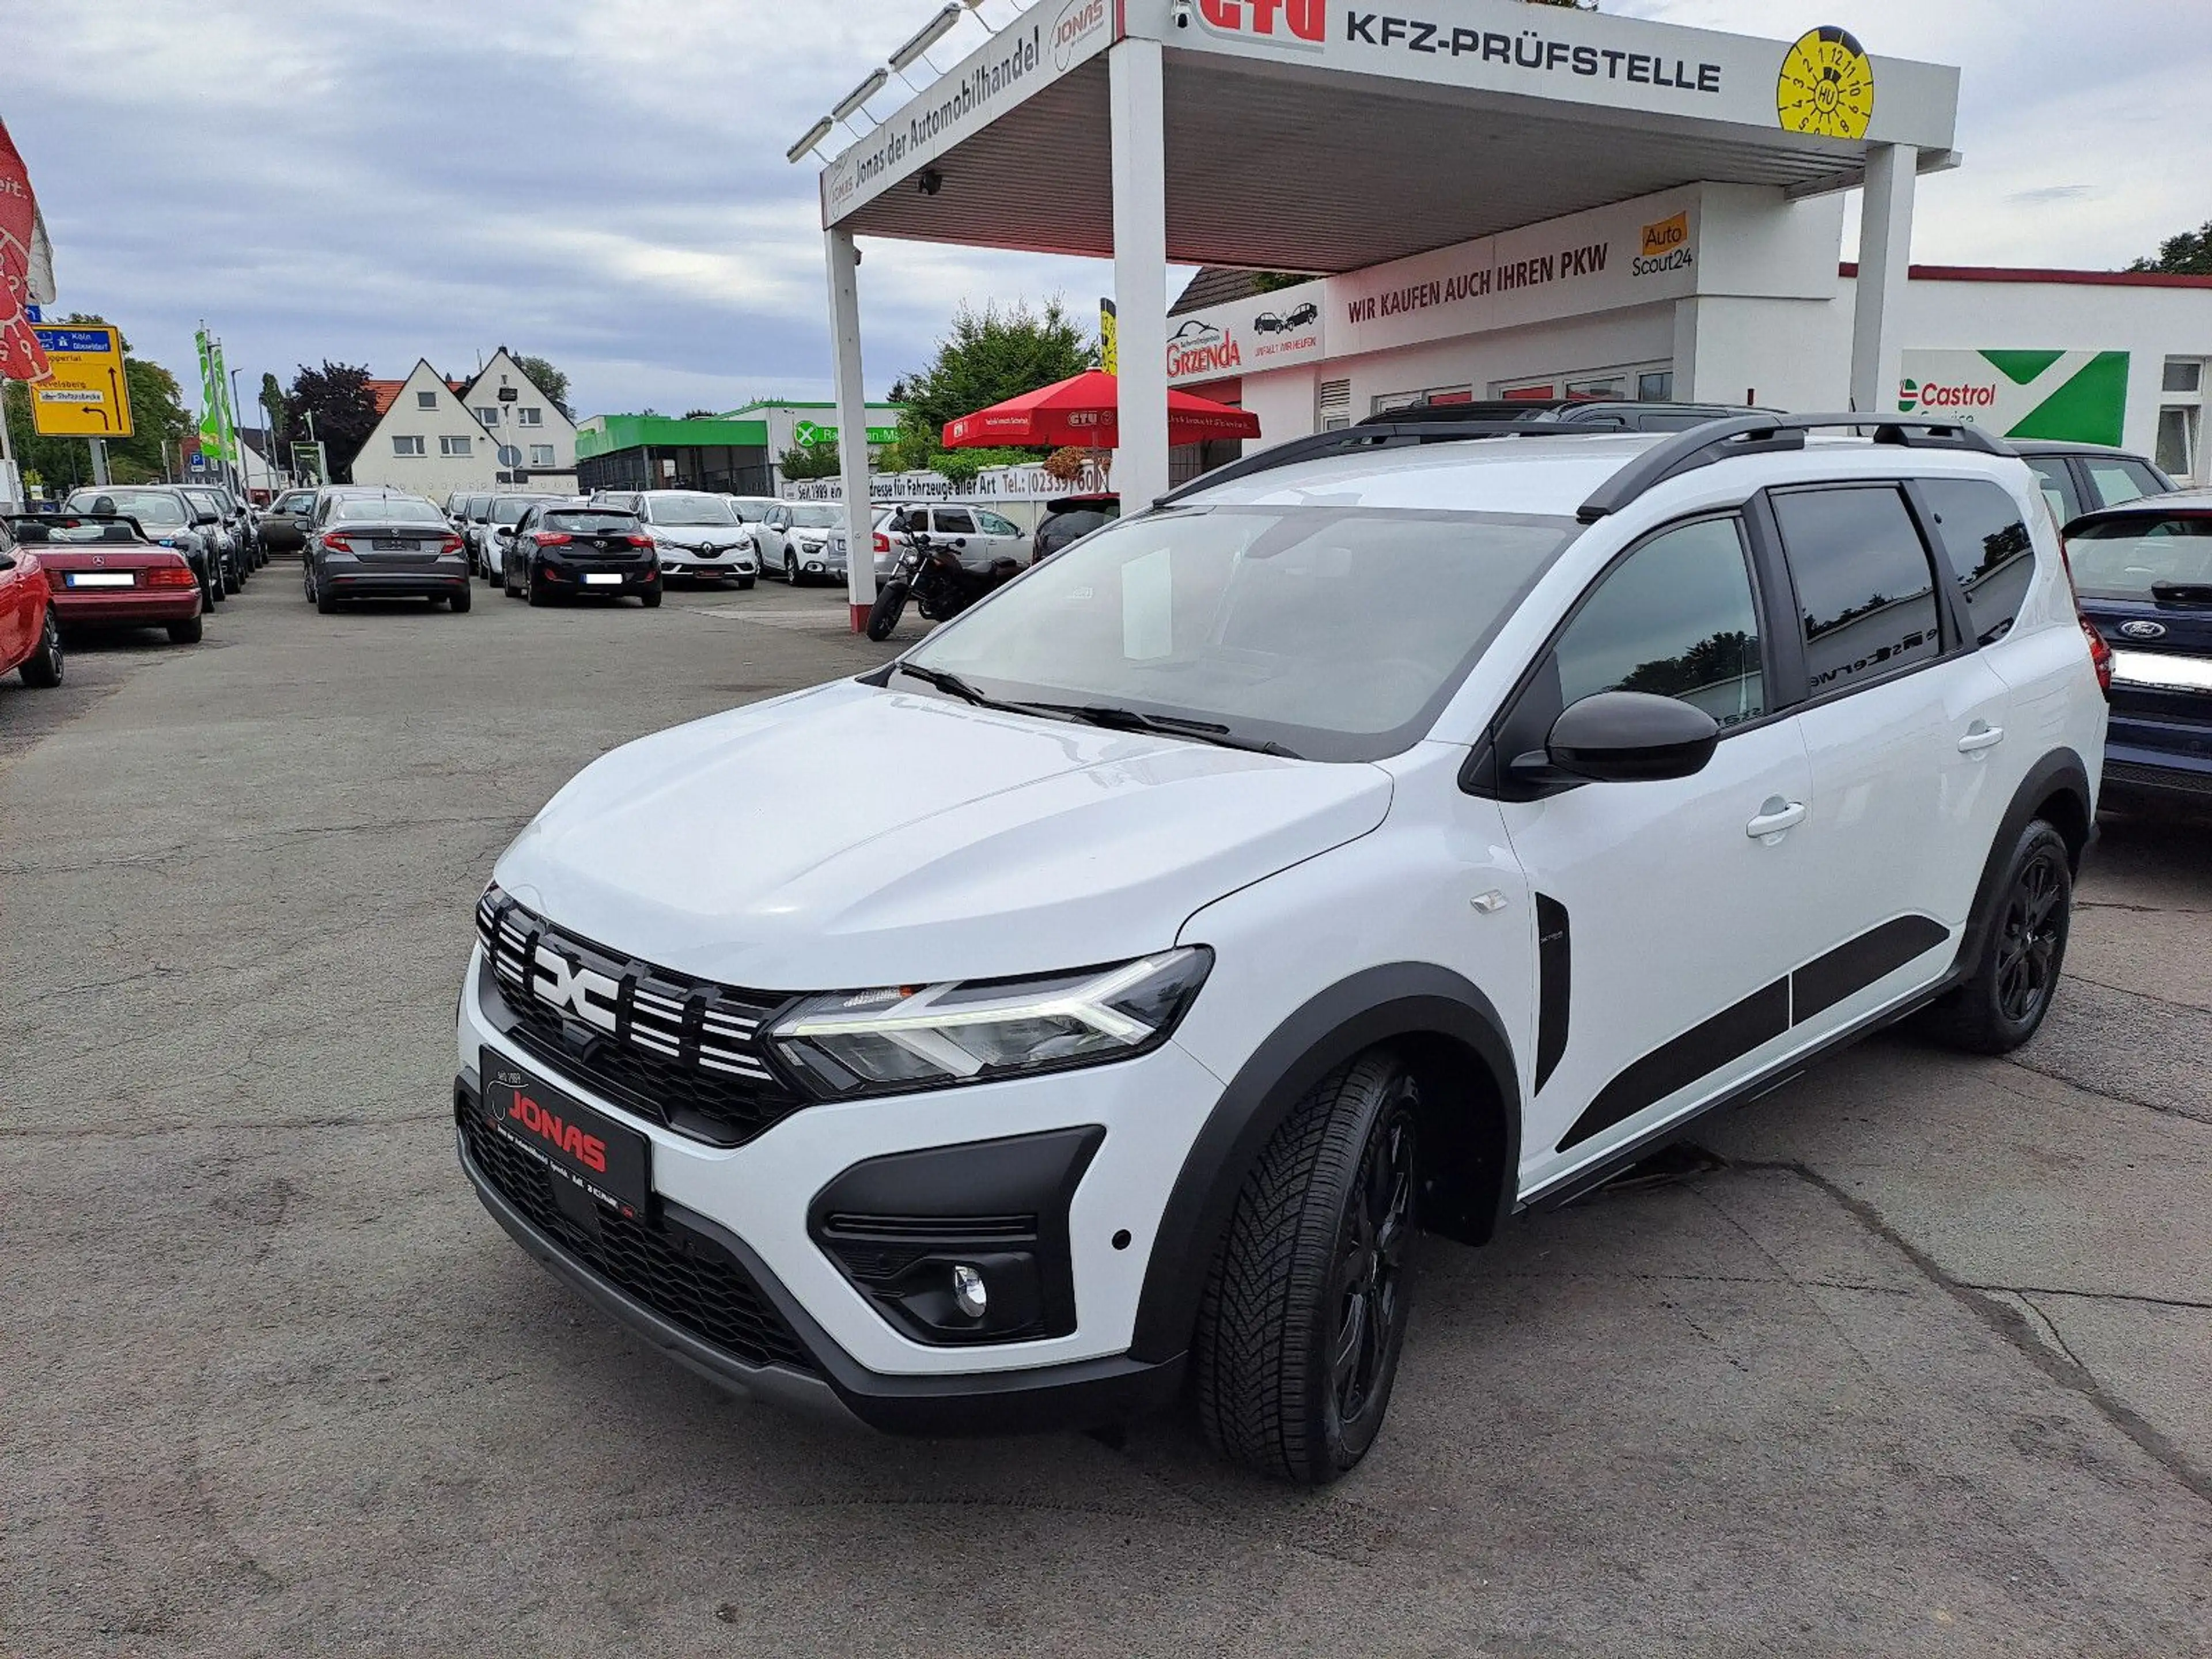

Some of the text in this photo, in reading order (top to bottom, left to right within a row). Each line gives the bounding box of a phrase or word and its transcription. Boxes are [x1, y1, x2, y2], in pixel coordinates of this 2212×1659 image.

[1346, 11, 1721, 92] KFZ-PRÜFSTELLE
[856, 149, 884, 188] Jonas
[888, 133, 906, 165] der
[910, 25, 1039, 151] Automobilhandel
[1633, 248, 1692, 276] Scout24
[1645, 226, 1681, 246] Auto
[1349, 243, 1608, 323] WIR KAUFEN AUCH IHREN PKW
[1922, 382, 1996, 406] Castrol
[980, 475, 996, 495] Art
[509, 1090, 607, 1173] JONAS
